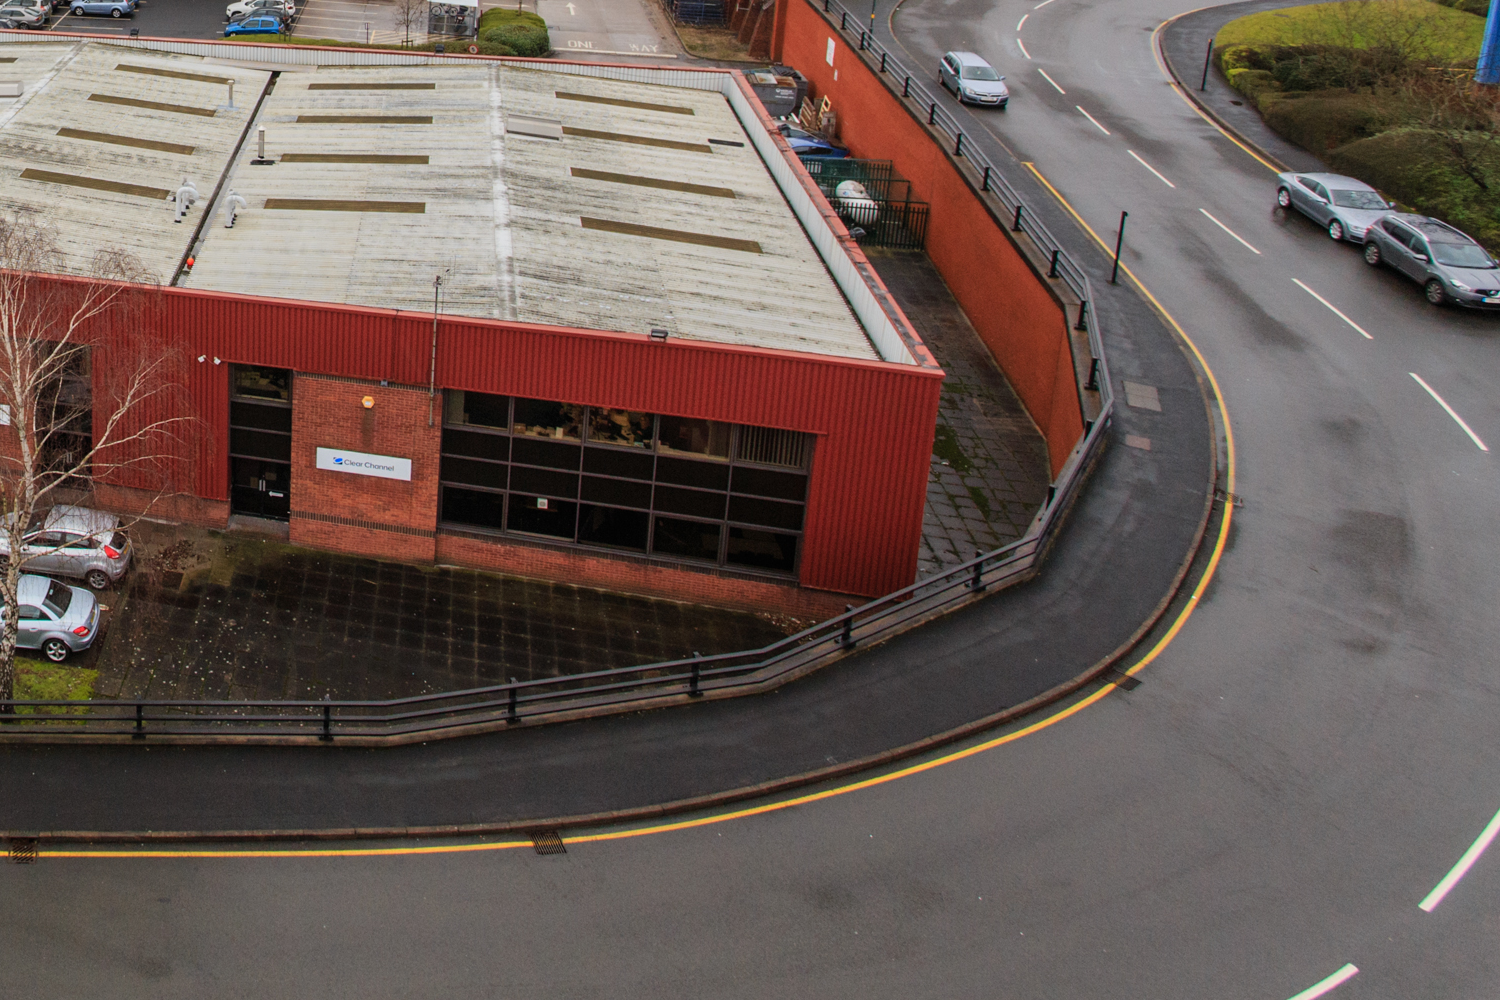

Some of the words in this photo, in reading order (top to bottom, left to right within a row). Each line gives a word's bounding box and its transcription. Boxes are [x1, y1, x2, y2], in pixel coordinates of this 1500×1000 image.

[628, 43, 659, 54] WAY
[343, 459, 363, 468] Clear
[364, 461, 395, 472] Channel
